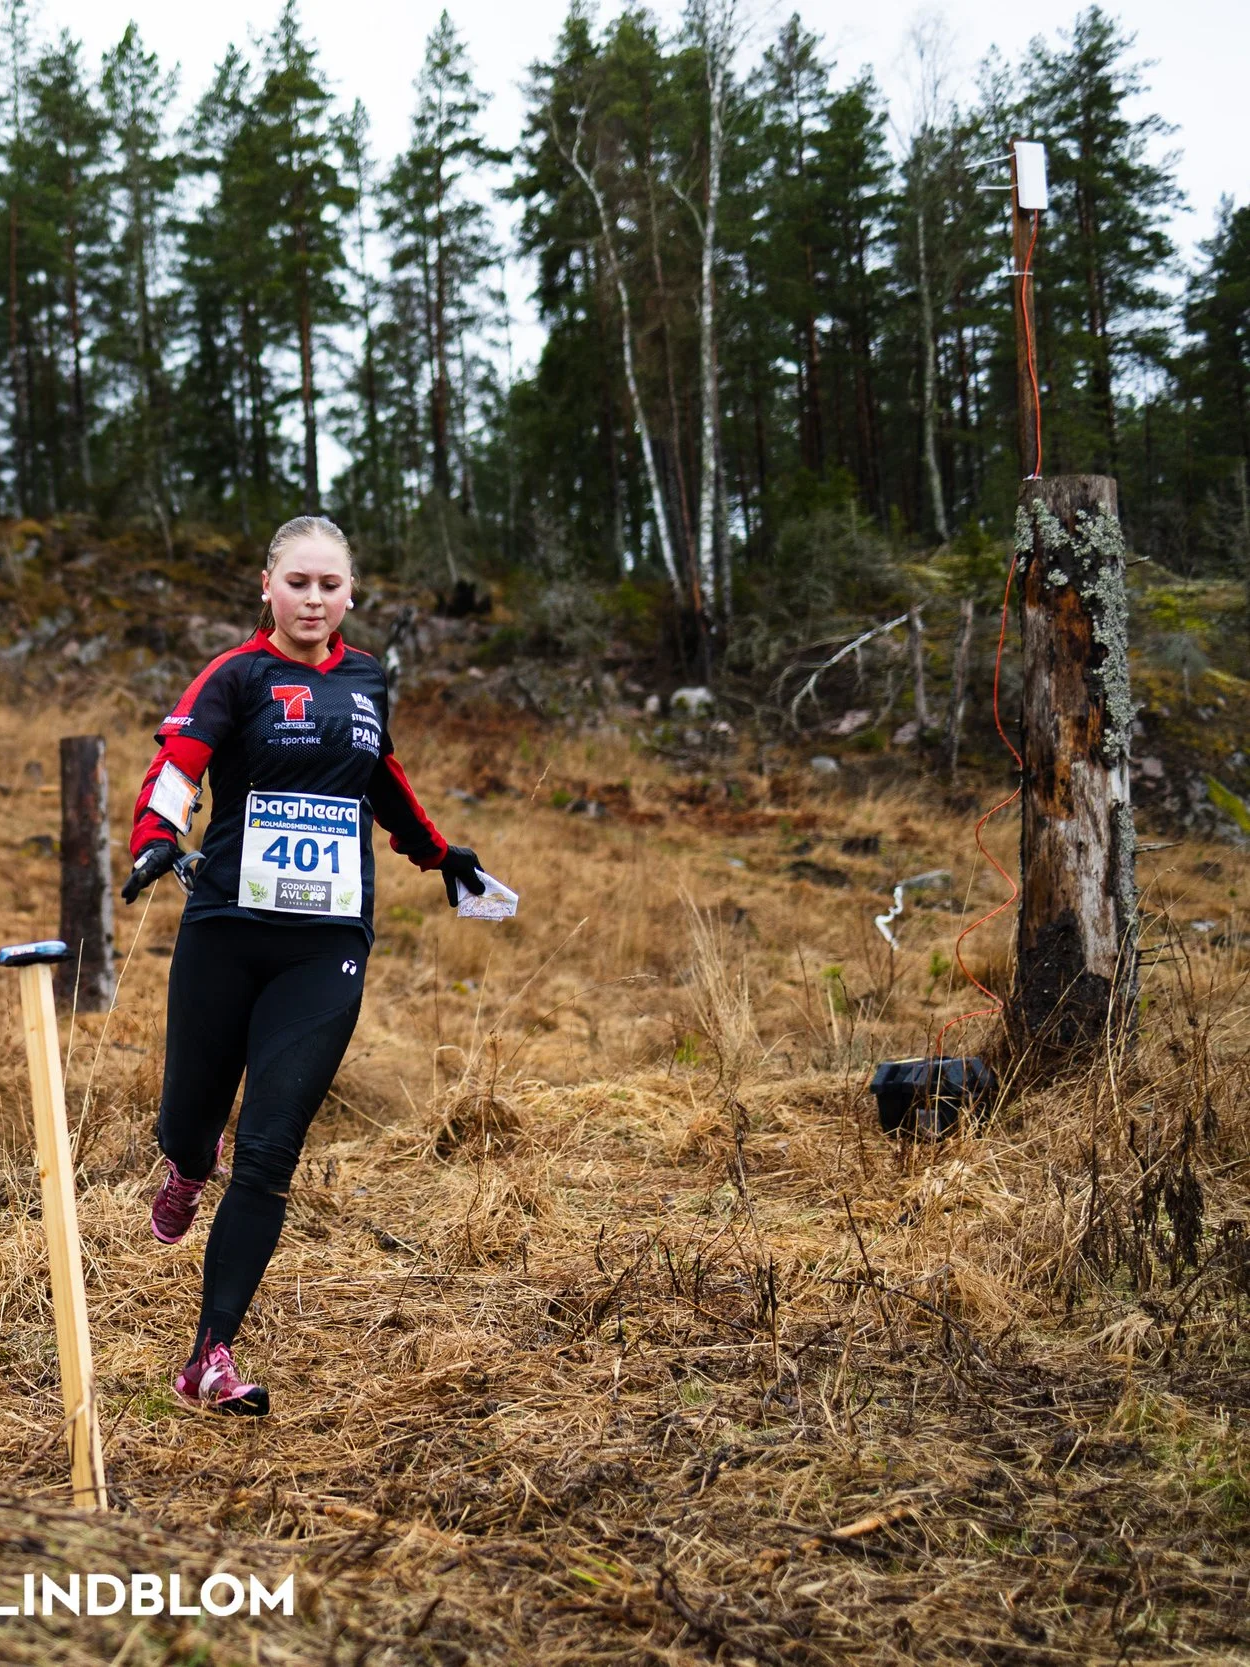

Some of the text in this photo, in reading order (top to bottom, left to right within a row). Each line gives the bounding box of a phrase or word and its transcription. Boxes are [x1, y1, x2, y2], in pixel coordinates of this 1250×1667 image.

[251, 796, 357, 822] bagheera
[262, 836, 340, 874] 401
[281, 882, 327, 893] GODKÄNDA
